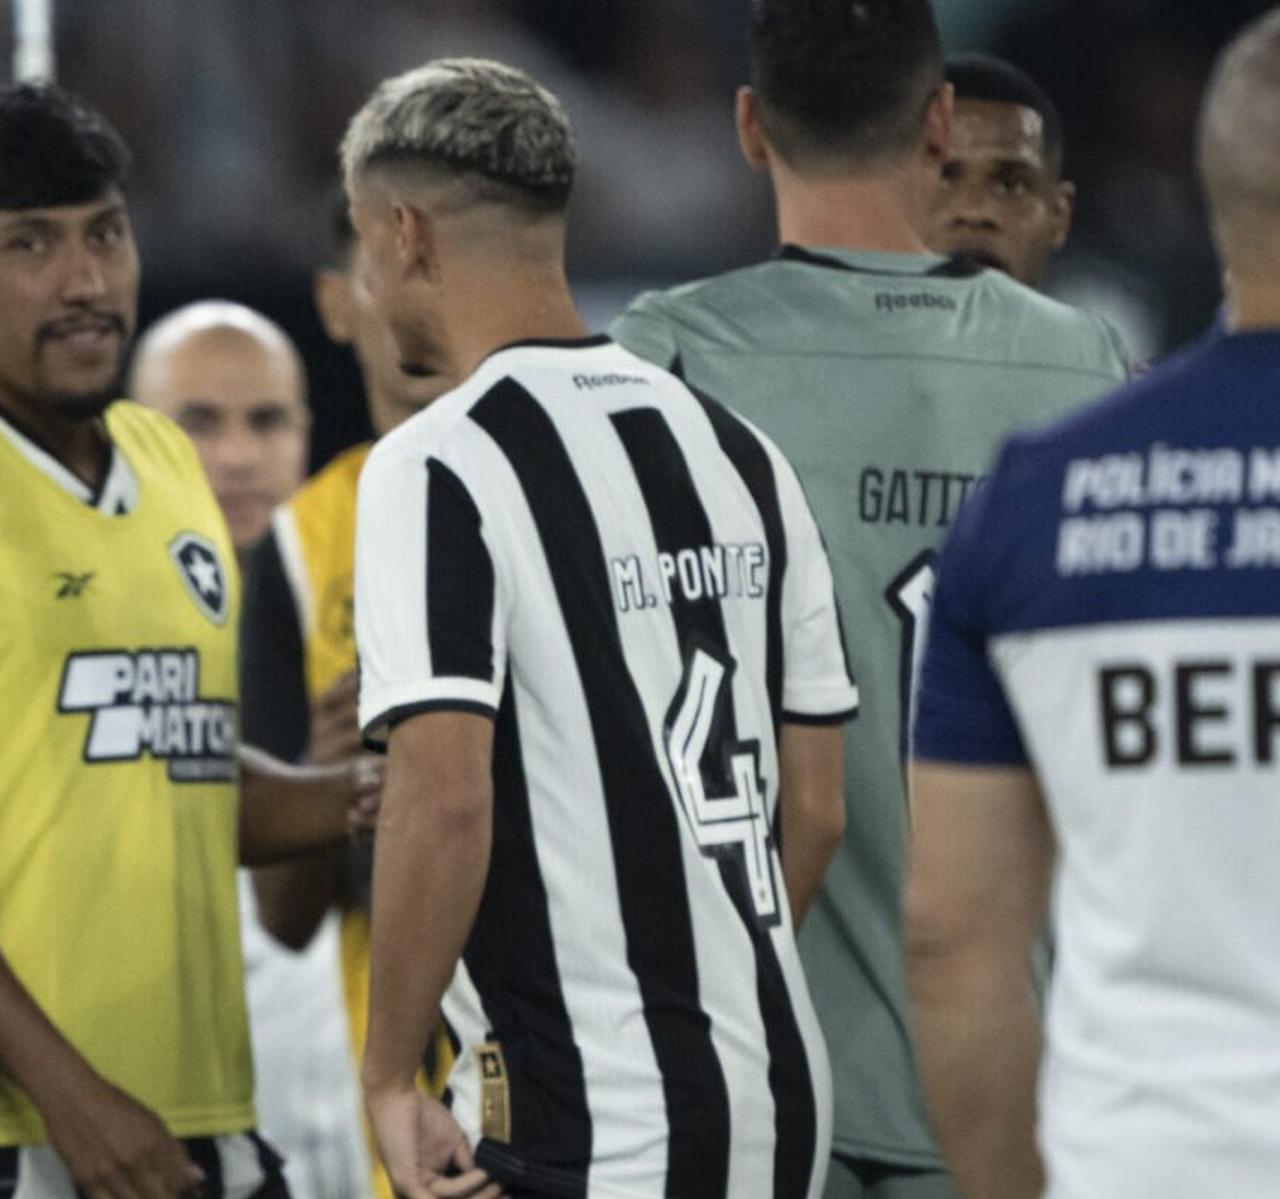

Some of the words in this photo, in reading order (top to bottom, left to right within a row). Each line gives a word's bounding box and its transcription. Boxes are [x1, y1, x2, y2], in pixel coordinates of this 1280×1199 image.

[1149, 507, 1217, 570] DE
[611, 554, 656, 612] M.
[657, 541, 765, 604] PONTE
[667, 650, 776, 918] 4
